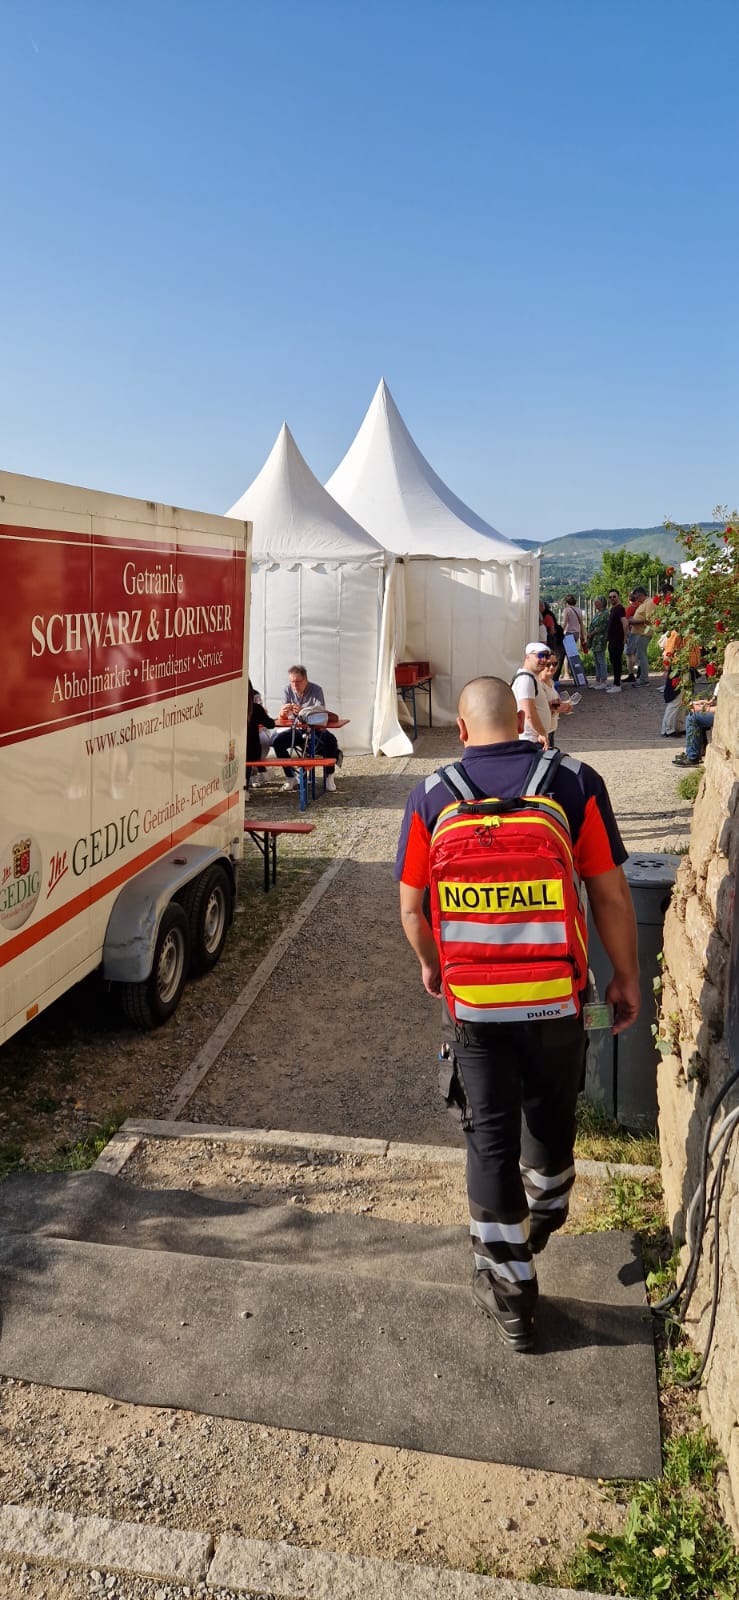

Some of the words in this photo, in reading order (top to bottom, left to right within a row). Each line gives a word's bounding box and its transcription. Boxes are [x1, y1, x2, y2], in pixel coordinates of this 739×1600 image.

[123, 561, 184, 595] Getränke
[31, 609, 143, 657] SCHWARZ
[146, 609, 160, 642] &
[164, 604, 232, 639] LORINSER
[51, 664, 131, 703] Abholmärkte
[141, 655, 191, 682] Heimdienst
[197, 648, 224, 670] Service
[85, 697, 204, 757] www.schwarz-lorinser.de
[72, 809, 140, 876] GEDIG
[0, 871, 40, 912] GEDIG
[445, 883, 557, 908] NOTFALL
[527, 1008, 561, 1019] pulox
